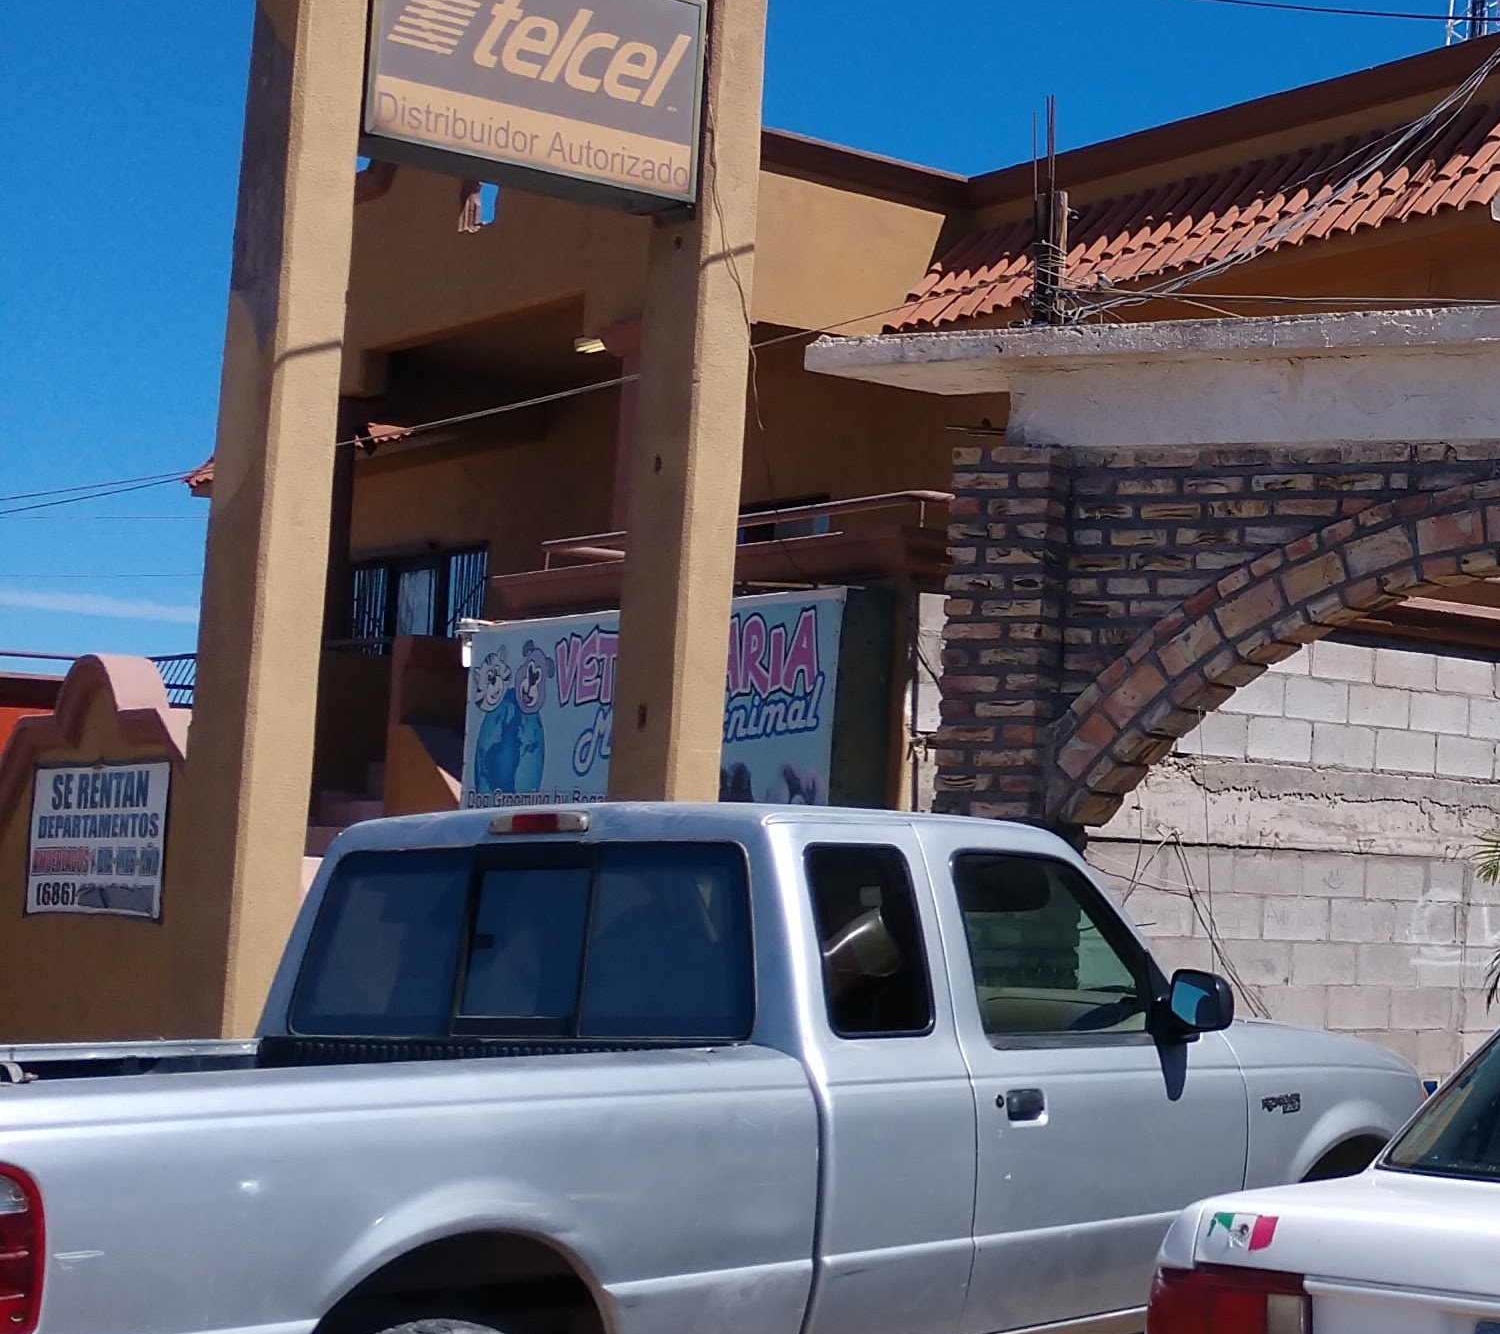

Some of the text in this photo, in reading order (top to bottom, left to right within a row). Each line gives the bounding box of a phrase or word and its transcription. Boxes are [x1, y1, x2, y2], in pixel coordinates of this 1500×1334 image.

[376, 90, 690, 190] Distribuidor Autorizado
[52, 769, 150, 811] SE RENTAN
[38, 812, 160, 840] DEPARTAMENTOS
